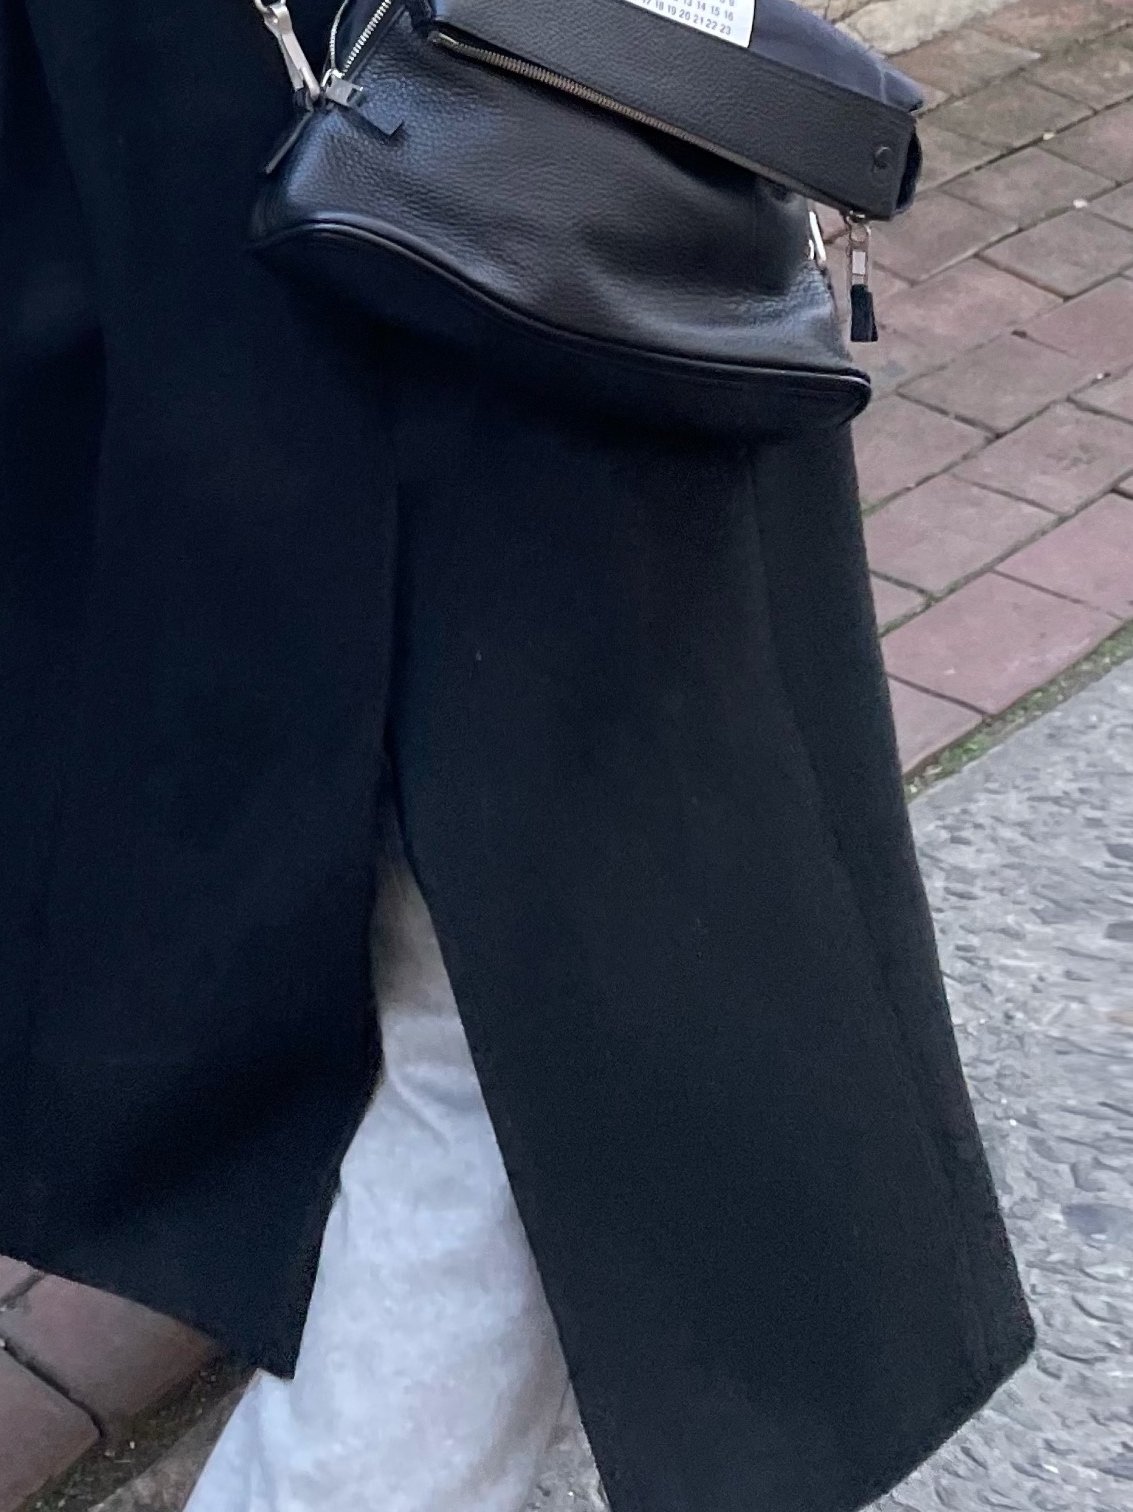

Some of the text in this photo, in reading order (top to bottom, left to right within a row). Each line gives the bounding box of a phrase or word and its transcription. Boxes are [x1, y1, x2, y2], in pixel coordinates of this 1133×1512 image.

[656, 0, 664, 10] 18
[668, 5, 676, 15] 19
[679, 10, 690, 20] 20
[693, 14, 704, 25] 21
[705, 19, 718, 30] 22
[720, 23, 731, 34] 23
[697, 1, 706, 11] 14
[711, 6, 720, 16] 15
[724, 10, 734, 21] 16
